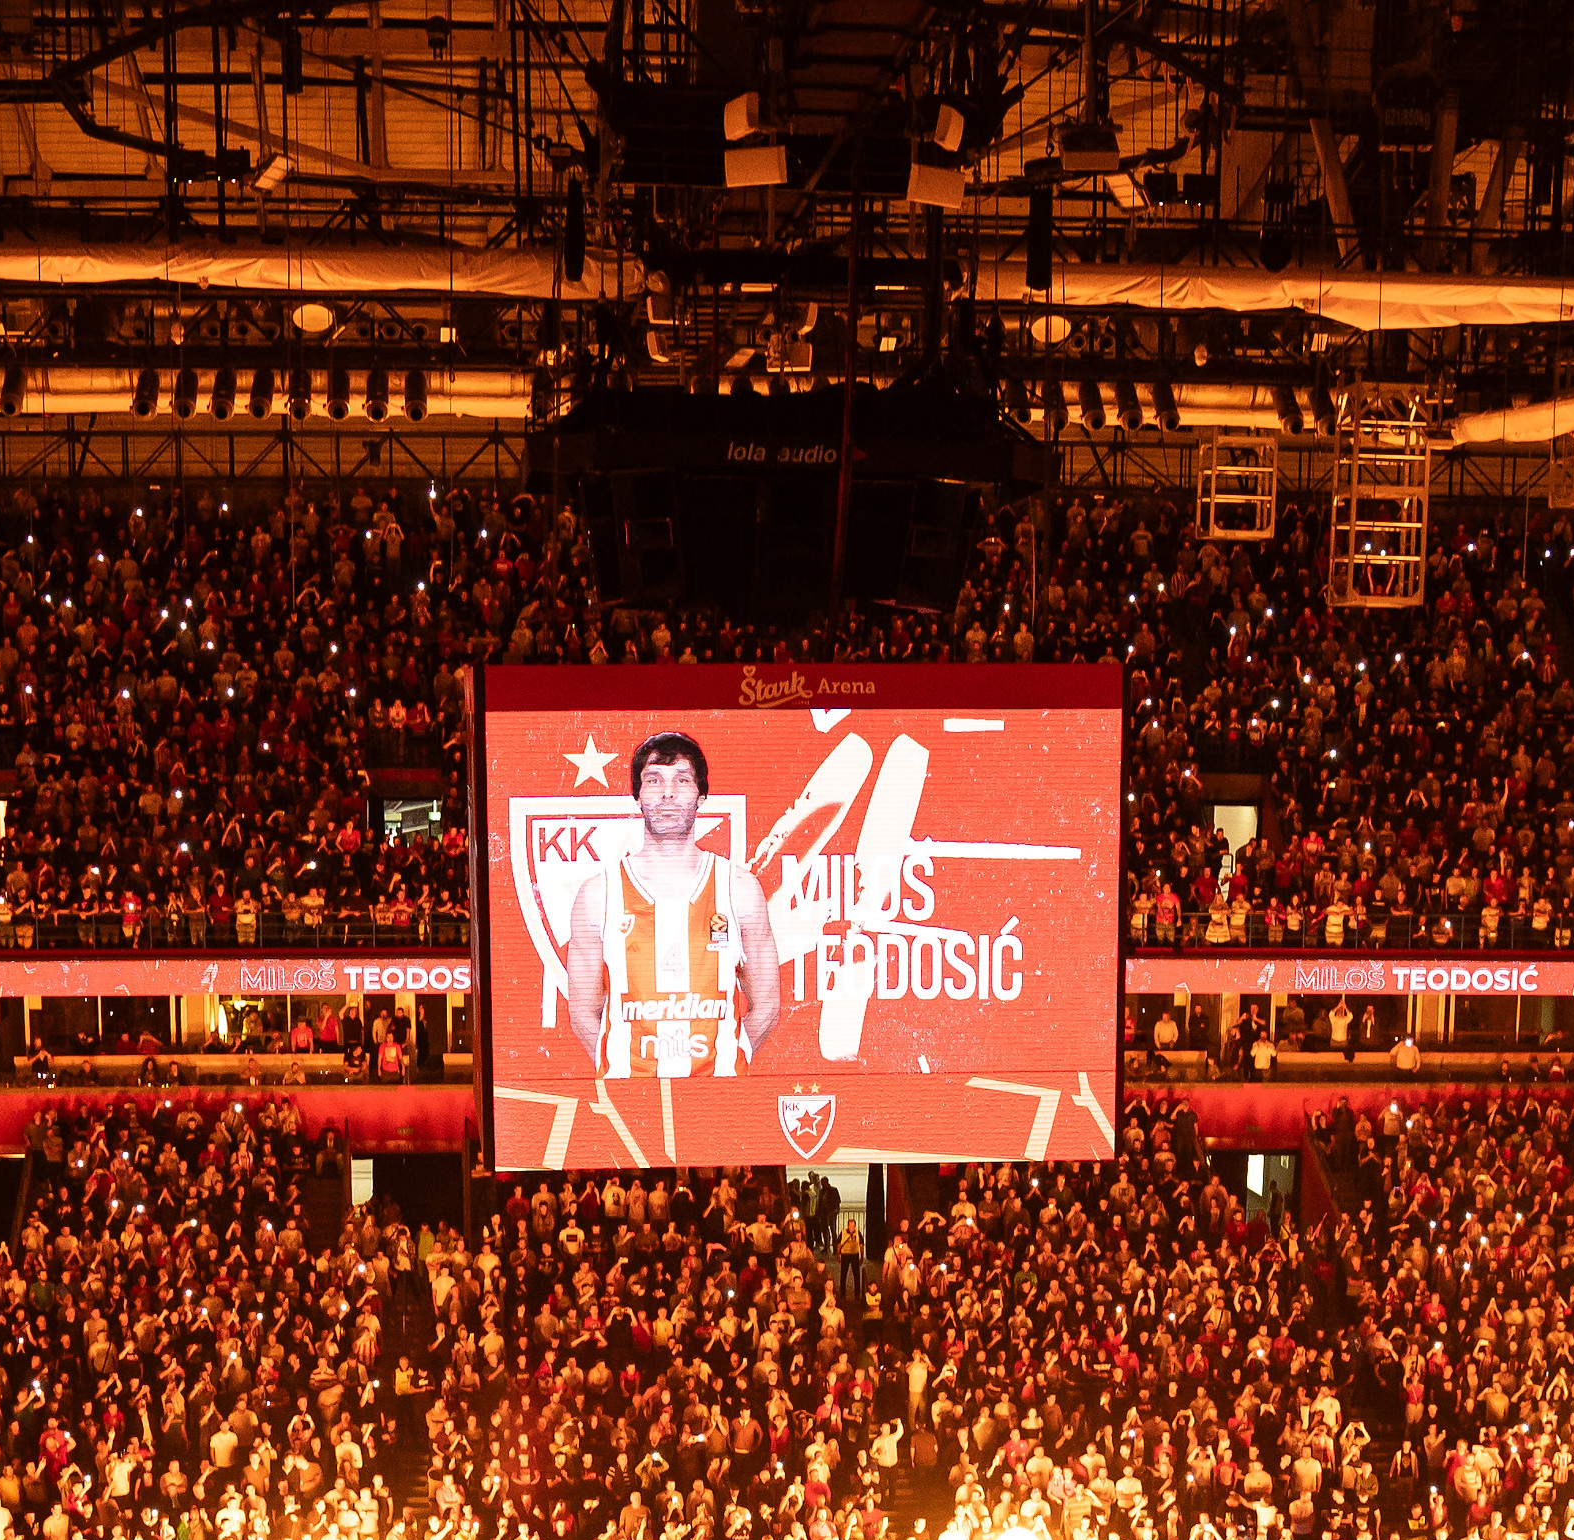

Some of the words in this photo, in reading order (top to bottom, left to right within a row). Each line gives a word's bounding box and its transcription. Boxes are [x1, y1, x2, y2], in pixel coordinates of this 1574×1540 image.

[726, 441, 766, 463] lola
[777, 443, 838, 464] audio
[739, 665, 814, 708] Štark
[816, 677, 876, 695] Arena
[538, 824, 601, 862] KK
[780, 842, 935, 922] MILOŠ
[787, 915, 1024, 1002] TEODOSIĆ
[240, 959, 337, 992] MILOŠ
[343, 966, 472, 992] TEODOS
[1294, 963, 1386, 992] MILOŠ
[1392, 963, 1539, 993] TEODOSIĆ
[623, 993, 728, 1021] meridian
[640, 1028, 709, 1059] mts
